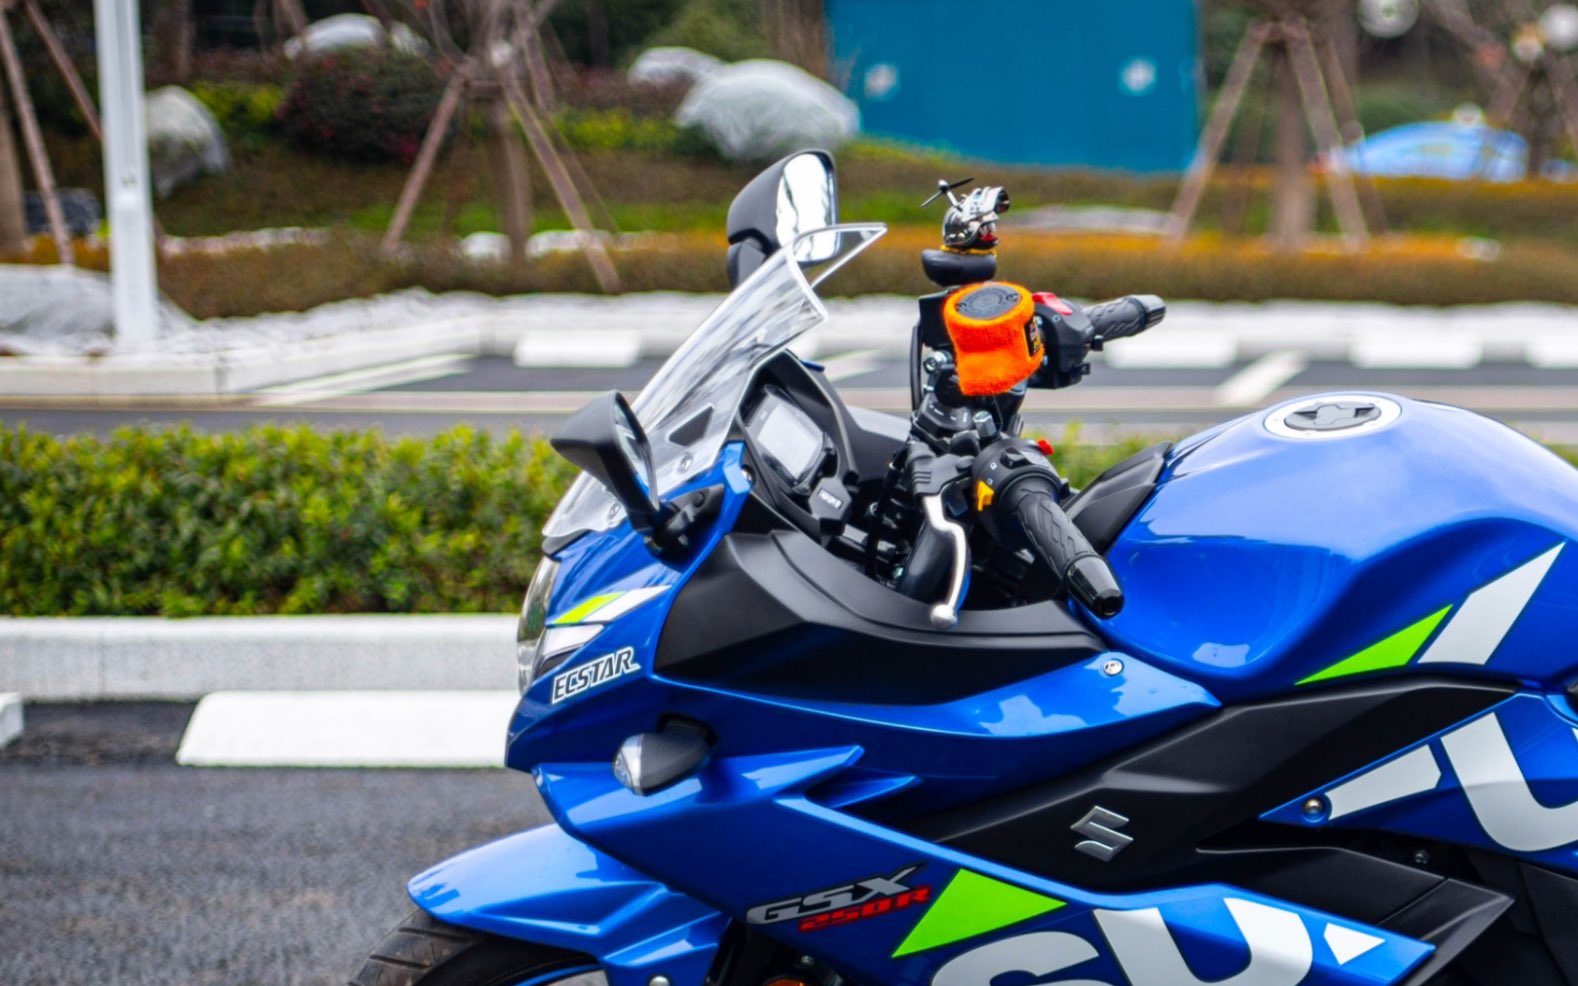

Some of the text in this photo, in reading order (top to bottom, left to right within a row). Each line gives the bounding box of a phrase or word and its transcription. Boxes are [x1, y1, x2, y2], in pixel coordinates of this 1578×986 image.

[552, 646, 641, 704] ECSTAR
[746, 866, 919, 925] GSX
[798, 885, 932, 932] 250R
